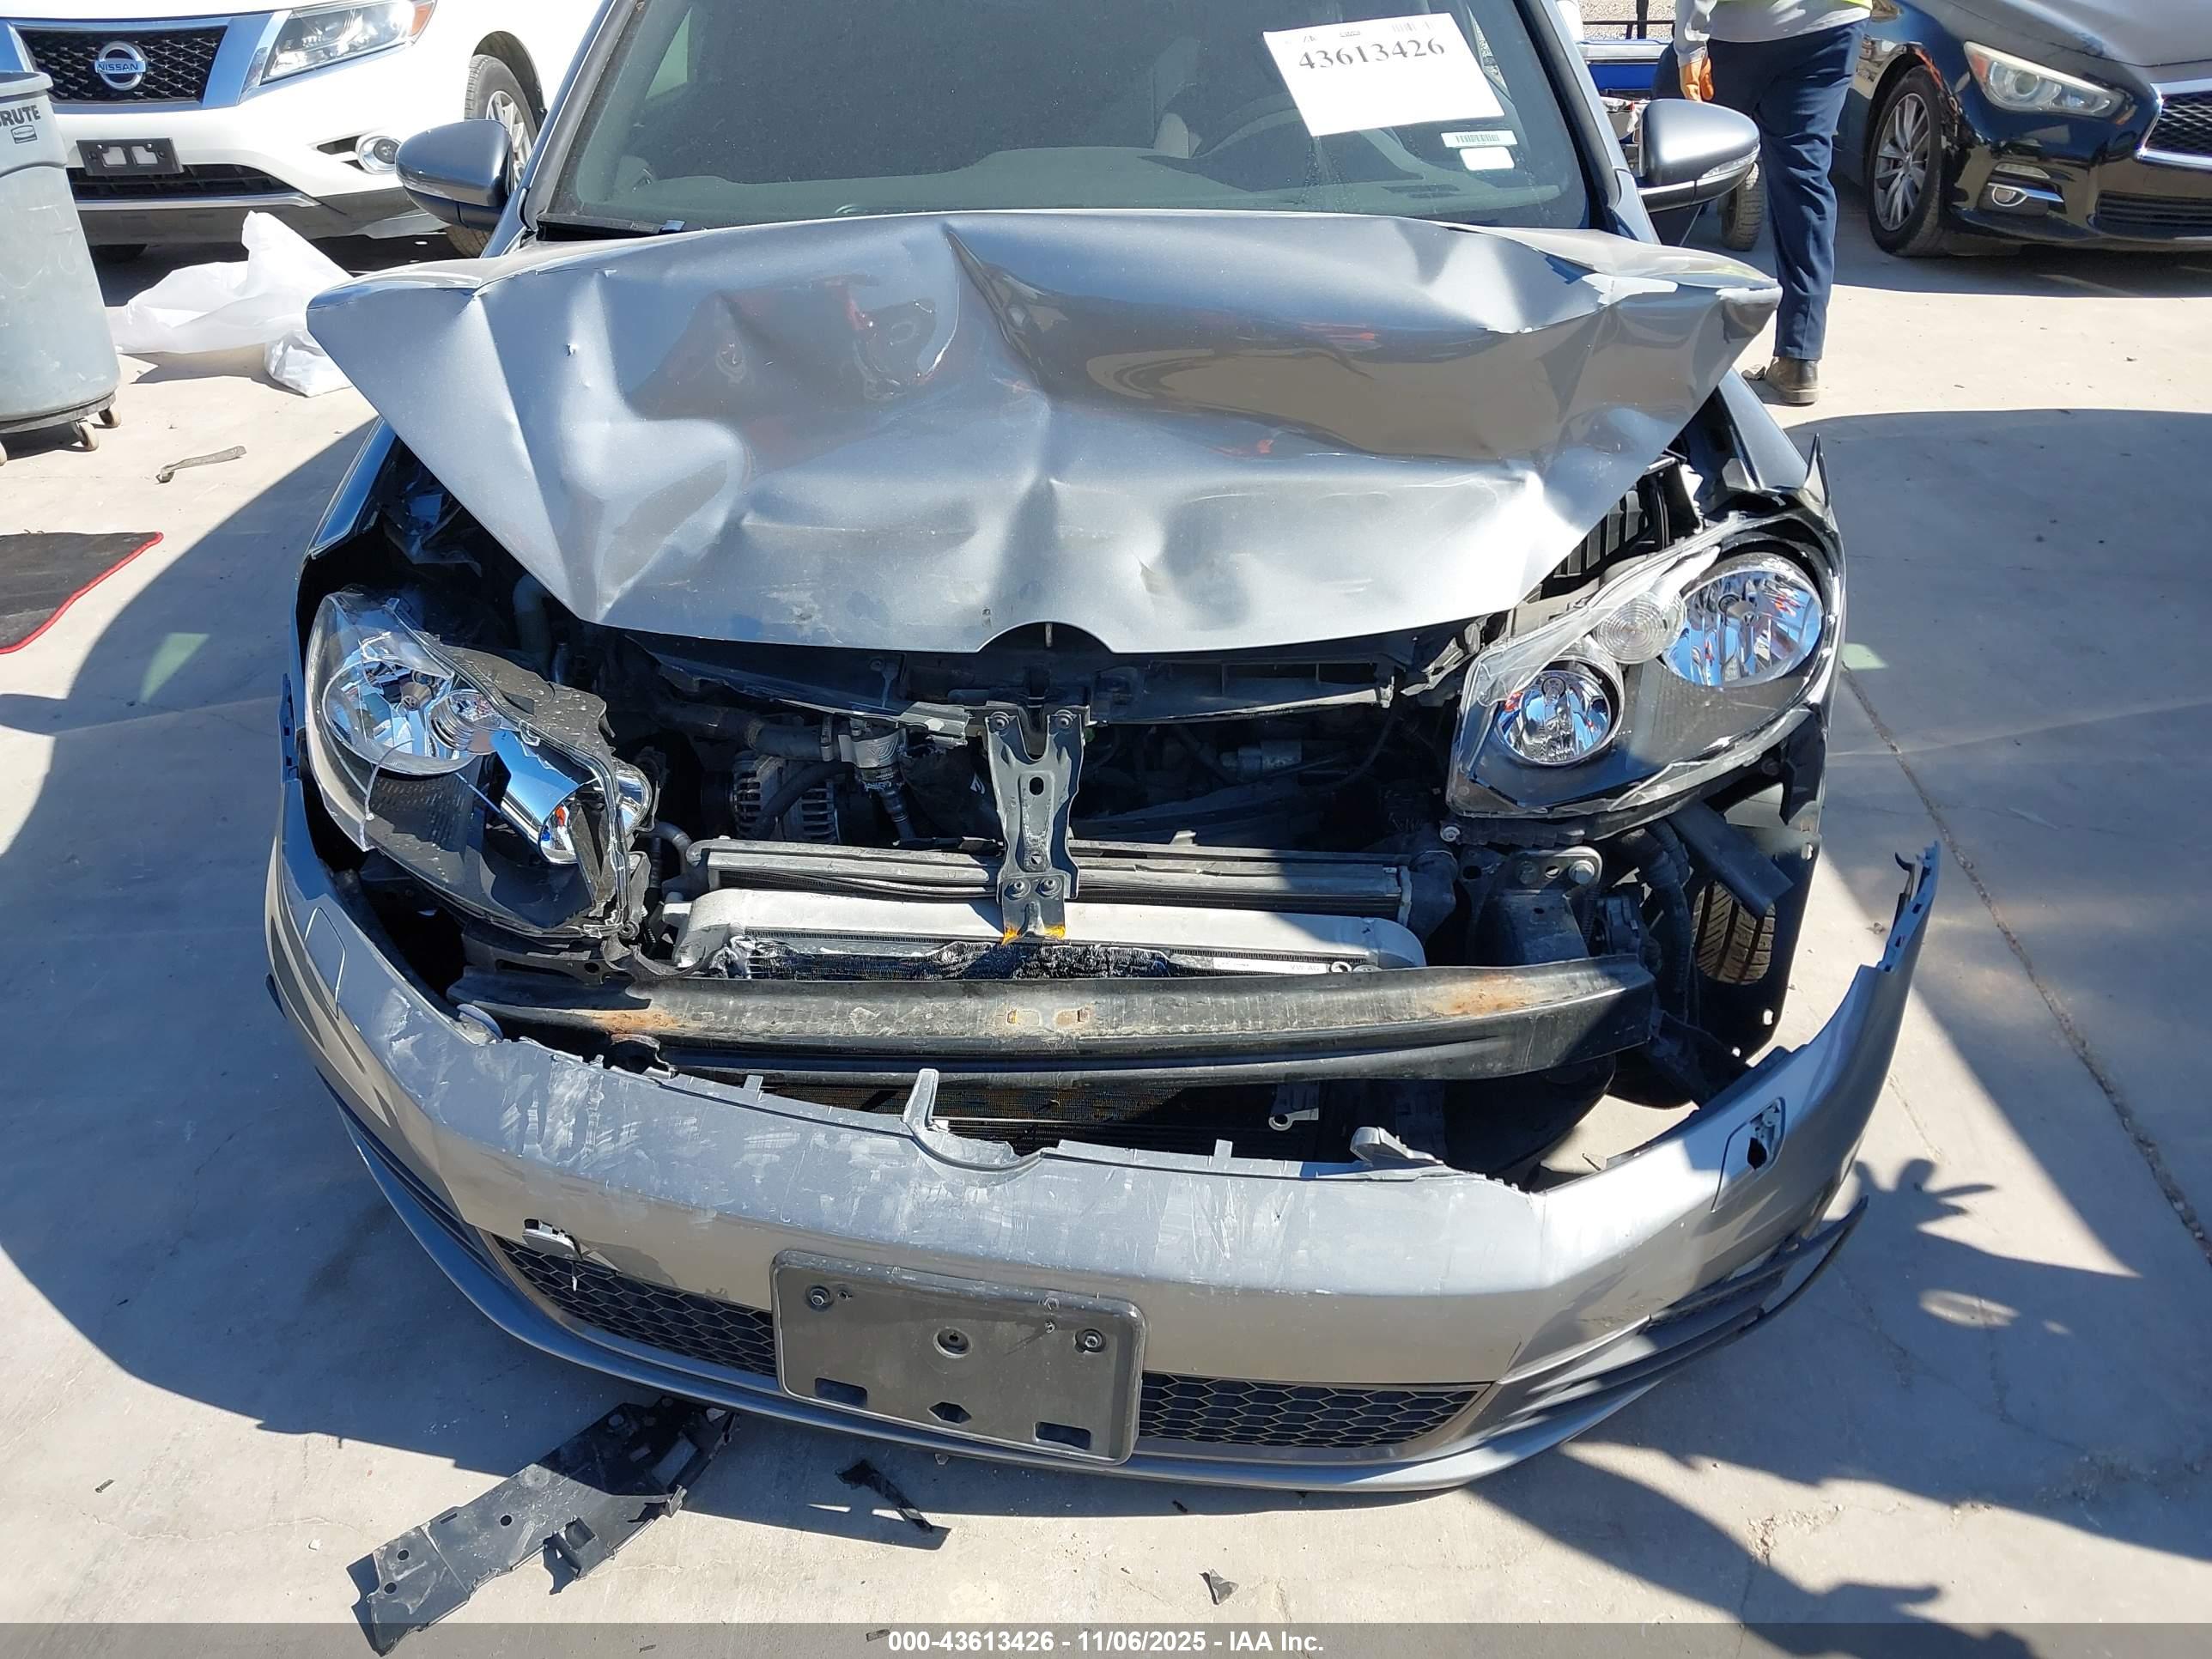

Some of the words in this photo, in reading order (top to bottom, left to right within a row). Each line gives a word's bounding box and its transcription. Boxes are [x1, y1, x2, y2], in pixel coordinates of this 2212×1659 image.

[1298, 37, 1445, 70] 43613426
[97, 64, 138, 72] NISSAN
[0, 105, 41, 127] RUTE
